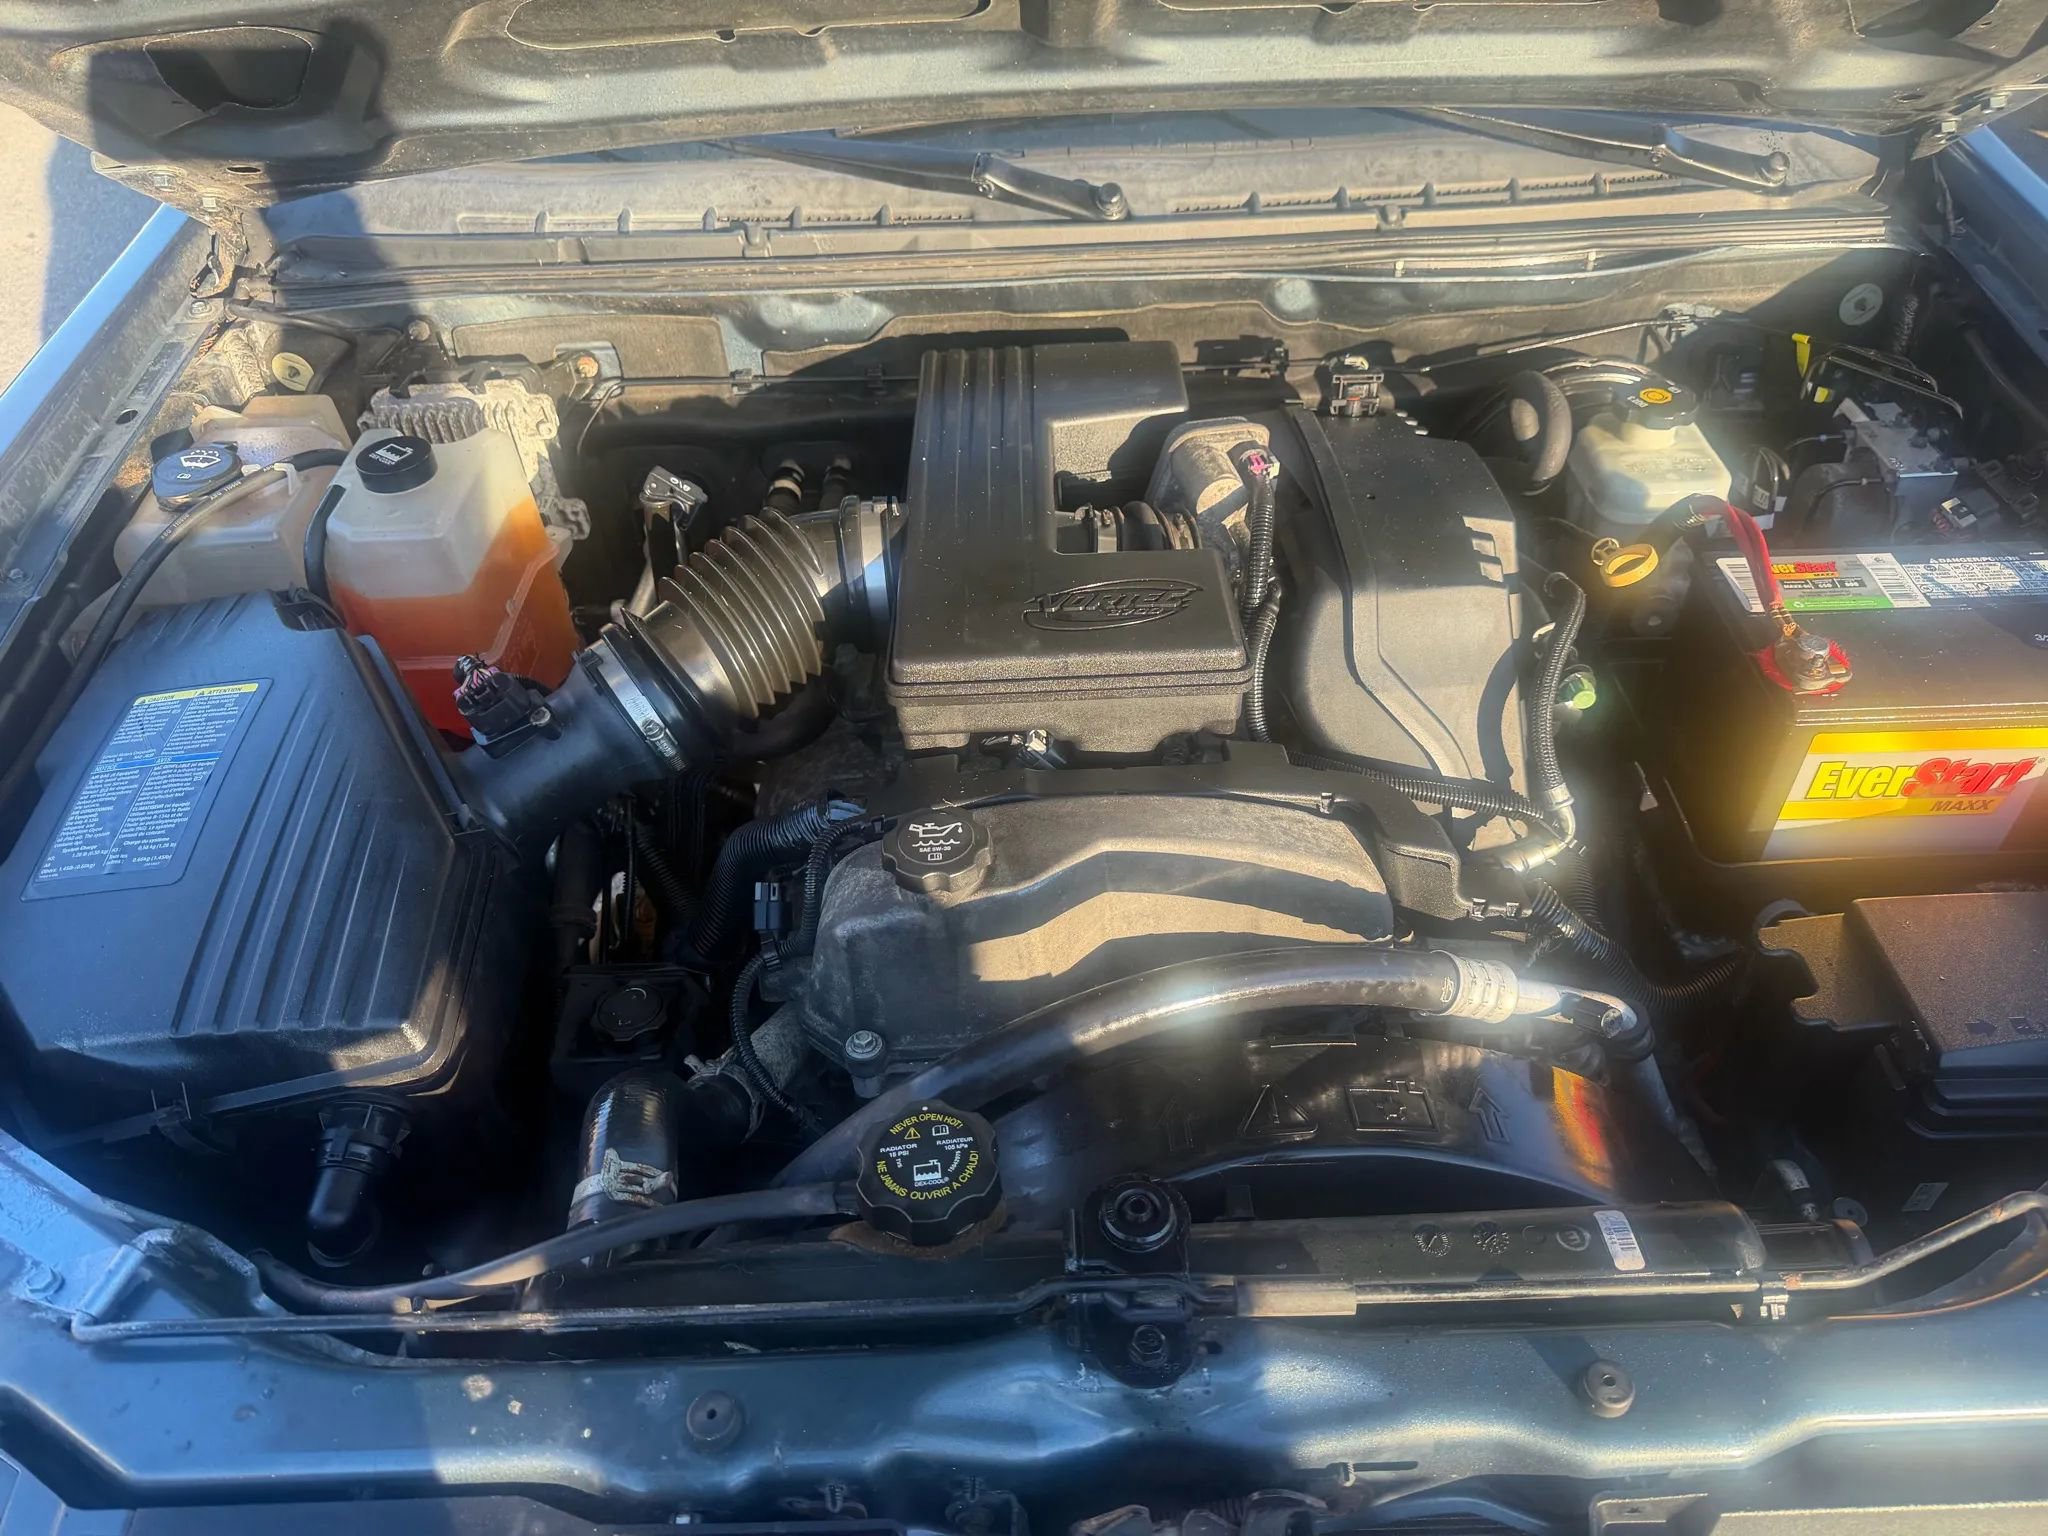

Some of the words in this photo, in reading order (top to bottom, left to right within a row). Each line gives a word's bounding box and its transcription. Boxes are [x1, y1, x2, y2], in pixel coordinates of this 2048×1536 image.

[1771, 561, 1838, 574] verStart
[148, 694, 175, 702] CAUTION
[1804, 757, 2039, 800] EverStart
[1930, 799, 1996, 812] MAXX
[890, 1116, 918, 1135] NEVER
[919, 1113, 944, 1122] OPEN
[944, 1116, 964, 1129] HOT!
[936, 1136, 974, 1146] RADIATEUR
[880, 1143, 918, 1153] RADIATOR
[876, 1160, 887, 1173] NE
[880, 1171, 908, 1198] JAMAIS
[909, 1187, 952, 1201] OUVRIR
